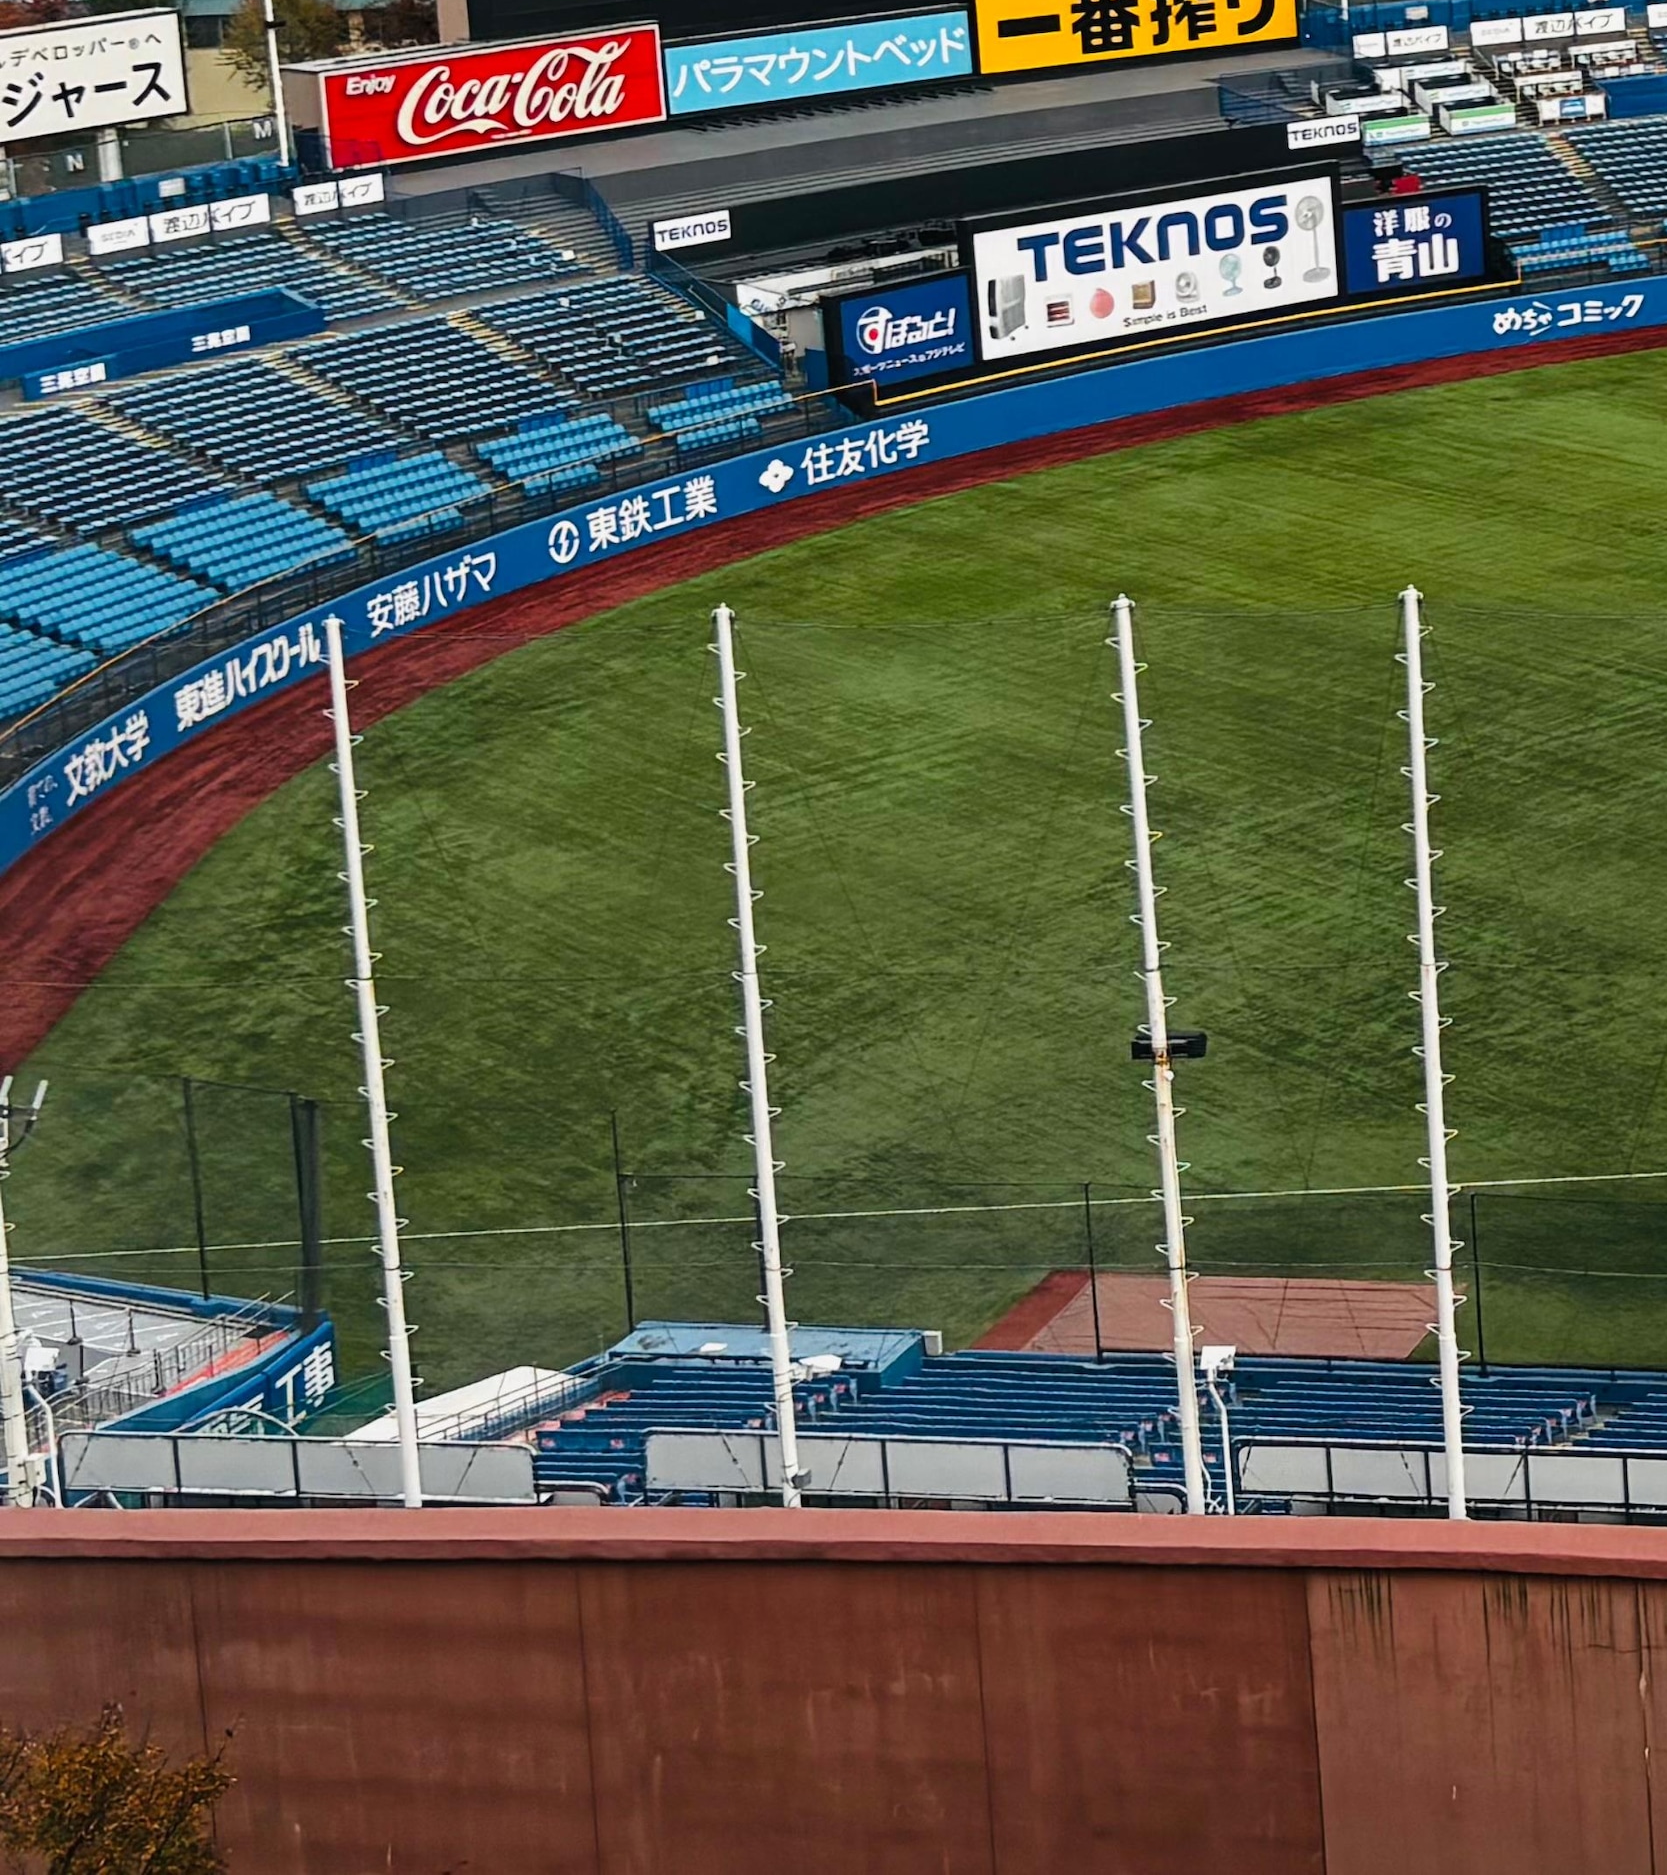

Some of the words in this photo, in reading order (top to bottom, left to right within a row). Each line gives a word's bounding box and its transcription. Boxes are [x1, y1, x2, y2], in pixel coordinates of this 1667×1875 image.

[0, 33, 162, 69] デベロッパー®へ
[674, 26, 966, 100] パラマウントベッド
[1, 60, 172, 127] ジャース
[346, 75, 397, 96] Enjoy
[398, 36, 632, 146] Coca-Cola
[255, 119, 273, 139] M
[1289, 122, 1358, 142] TEKNOS
[67, 154, 84, 172] N
[656, 218, 729, 244] TEKNOS
[1017, 195, 1288, 282] TEKNOS
[1372, 205, 1452, 237] 洋服の
[1371, 234, 1459, 283] 青山
[1492, 293, 1645, 335] めちゃコミック
[801, 419, 929, 485] 住友化学
[588, 475, 718, 553] 東鉄工業
[366, 551, 497, 637] 安藤ハザマ
[175, 623, 321, 732] 東進ハイスクール
[64, 710, 150, 807] 文教大学
